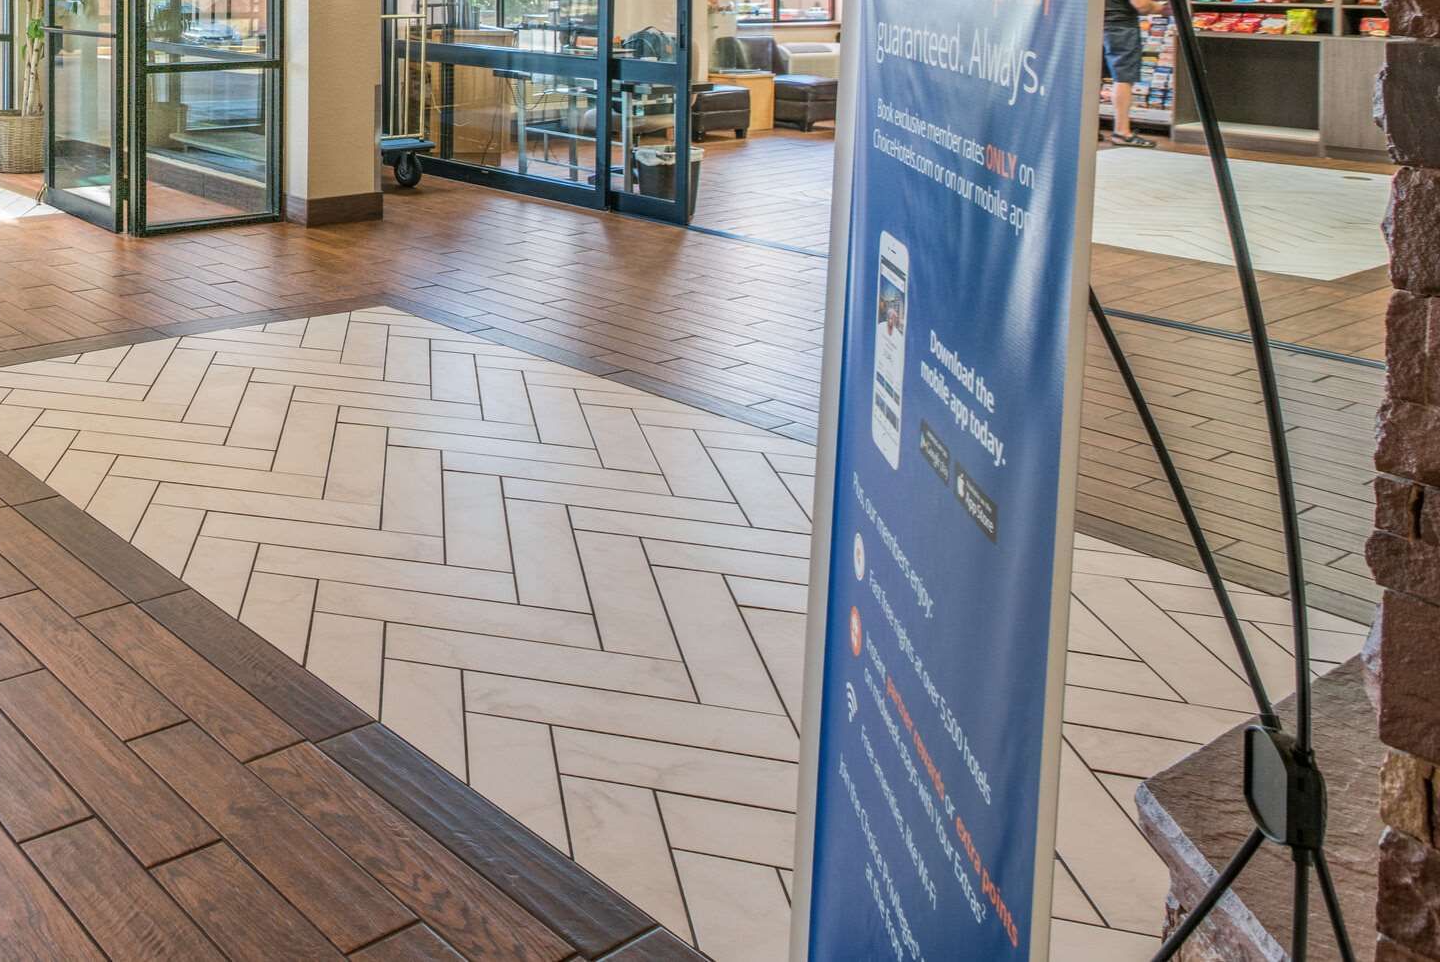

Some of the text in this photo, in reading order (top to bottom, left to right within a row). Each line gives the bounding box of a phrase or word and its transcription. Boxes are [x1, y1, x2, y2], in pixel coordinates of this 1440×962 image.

[876, 21, 1045, 106] guaranteed. Always.
[873, 128, 934, 178] ChoiceHotels.com
[934, 163, 945, 184] or
[945, 168, 957, 192] on
[957, 176, 974, 201] our
[975, 184, 1008, 221] mobile
[877, 97, 1035, 189] Book exclusive member rates ONLY on
[921, 359, 950, 406] mobile
[950, 392, 969, 432] app
[970, 409, 1007, 467] today.
[930, 328, 975, 394] Download
[976, 375, 995, 414] the
[963, 735, 991, 806] hotels
[945, 793, 956, 820] or
[956, 815, 981, 876] extra
[981, 866, 1019, 948] points
